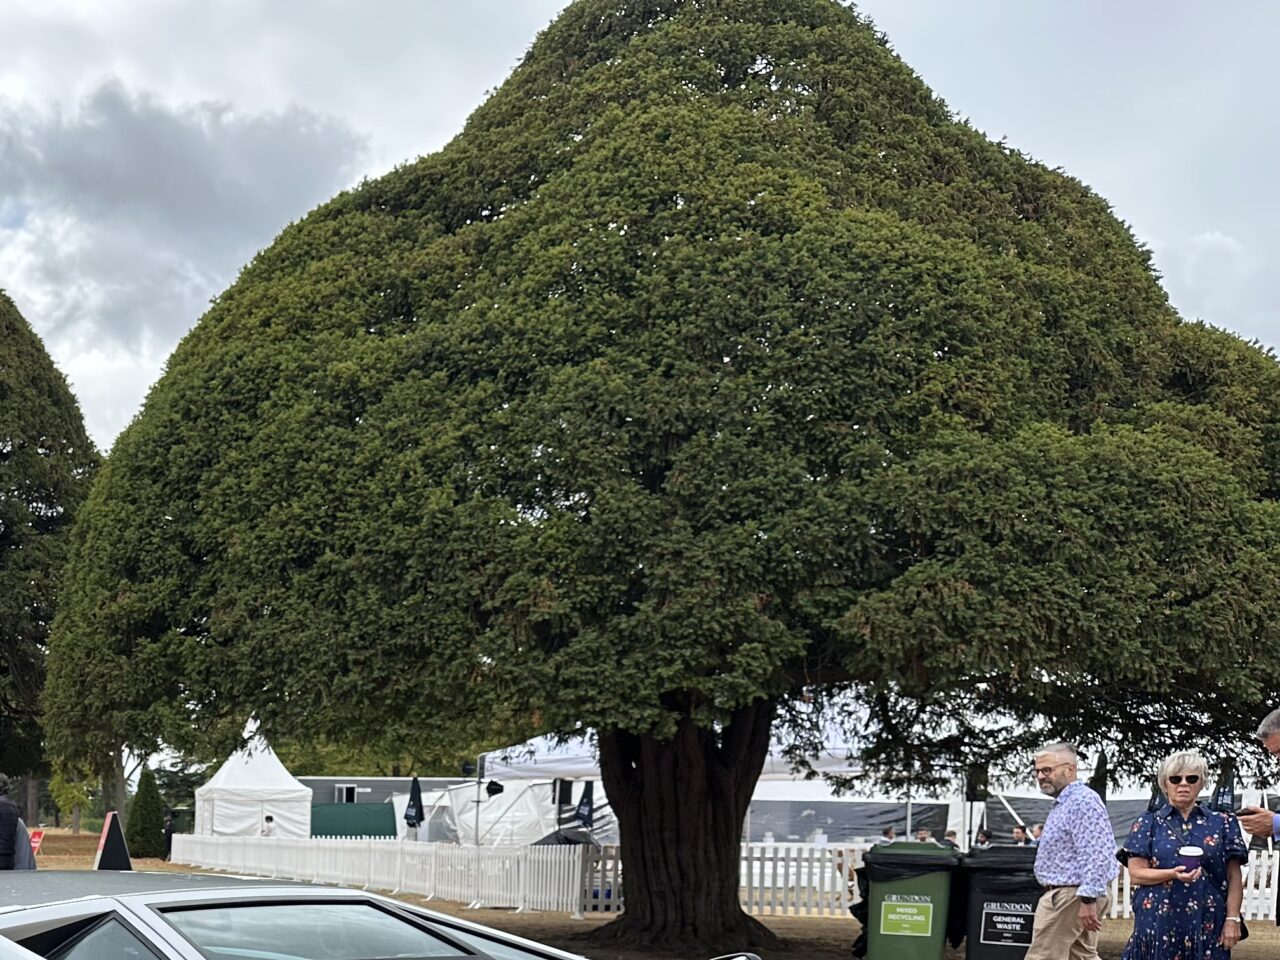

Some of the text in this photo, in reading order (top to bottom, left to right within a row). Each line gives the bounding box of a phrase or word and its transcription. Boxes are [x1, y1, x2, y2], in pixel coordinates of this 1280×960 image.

[885, 894, 931, 903] GRUNDON
[983, 902, 1032, 912] GRUNDON
[887, 913, 926, 921] RECYCLING
[992, 915, 1026, 924] GENERAL
